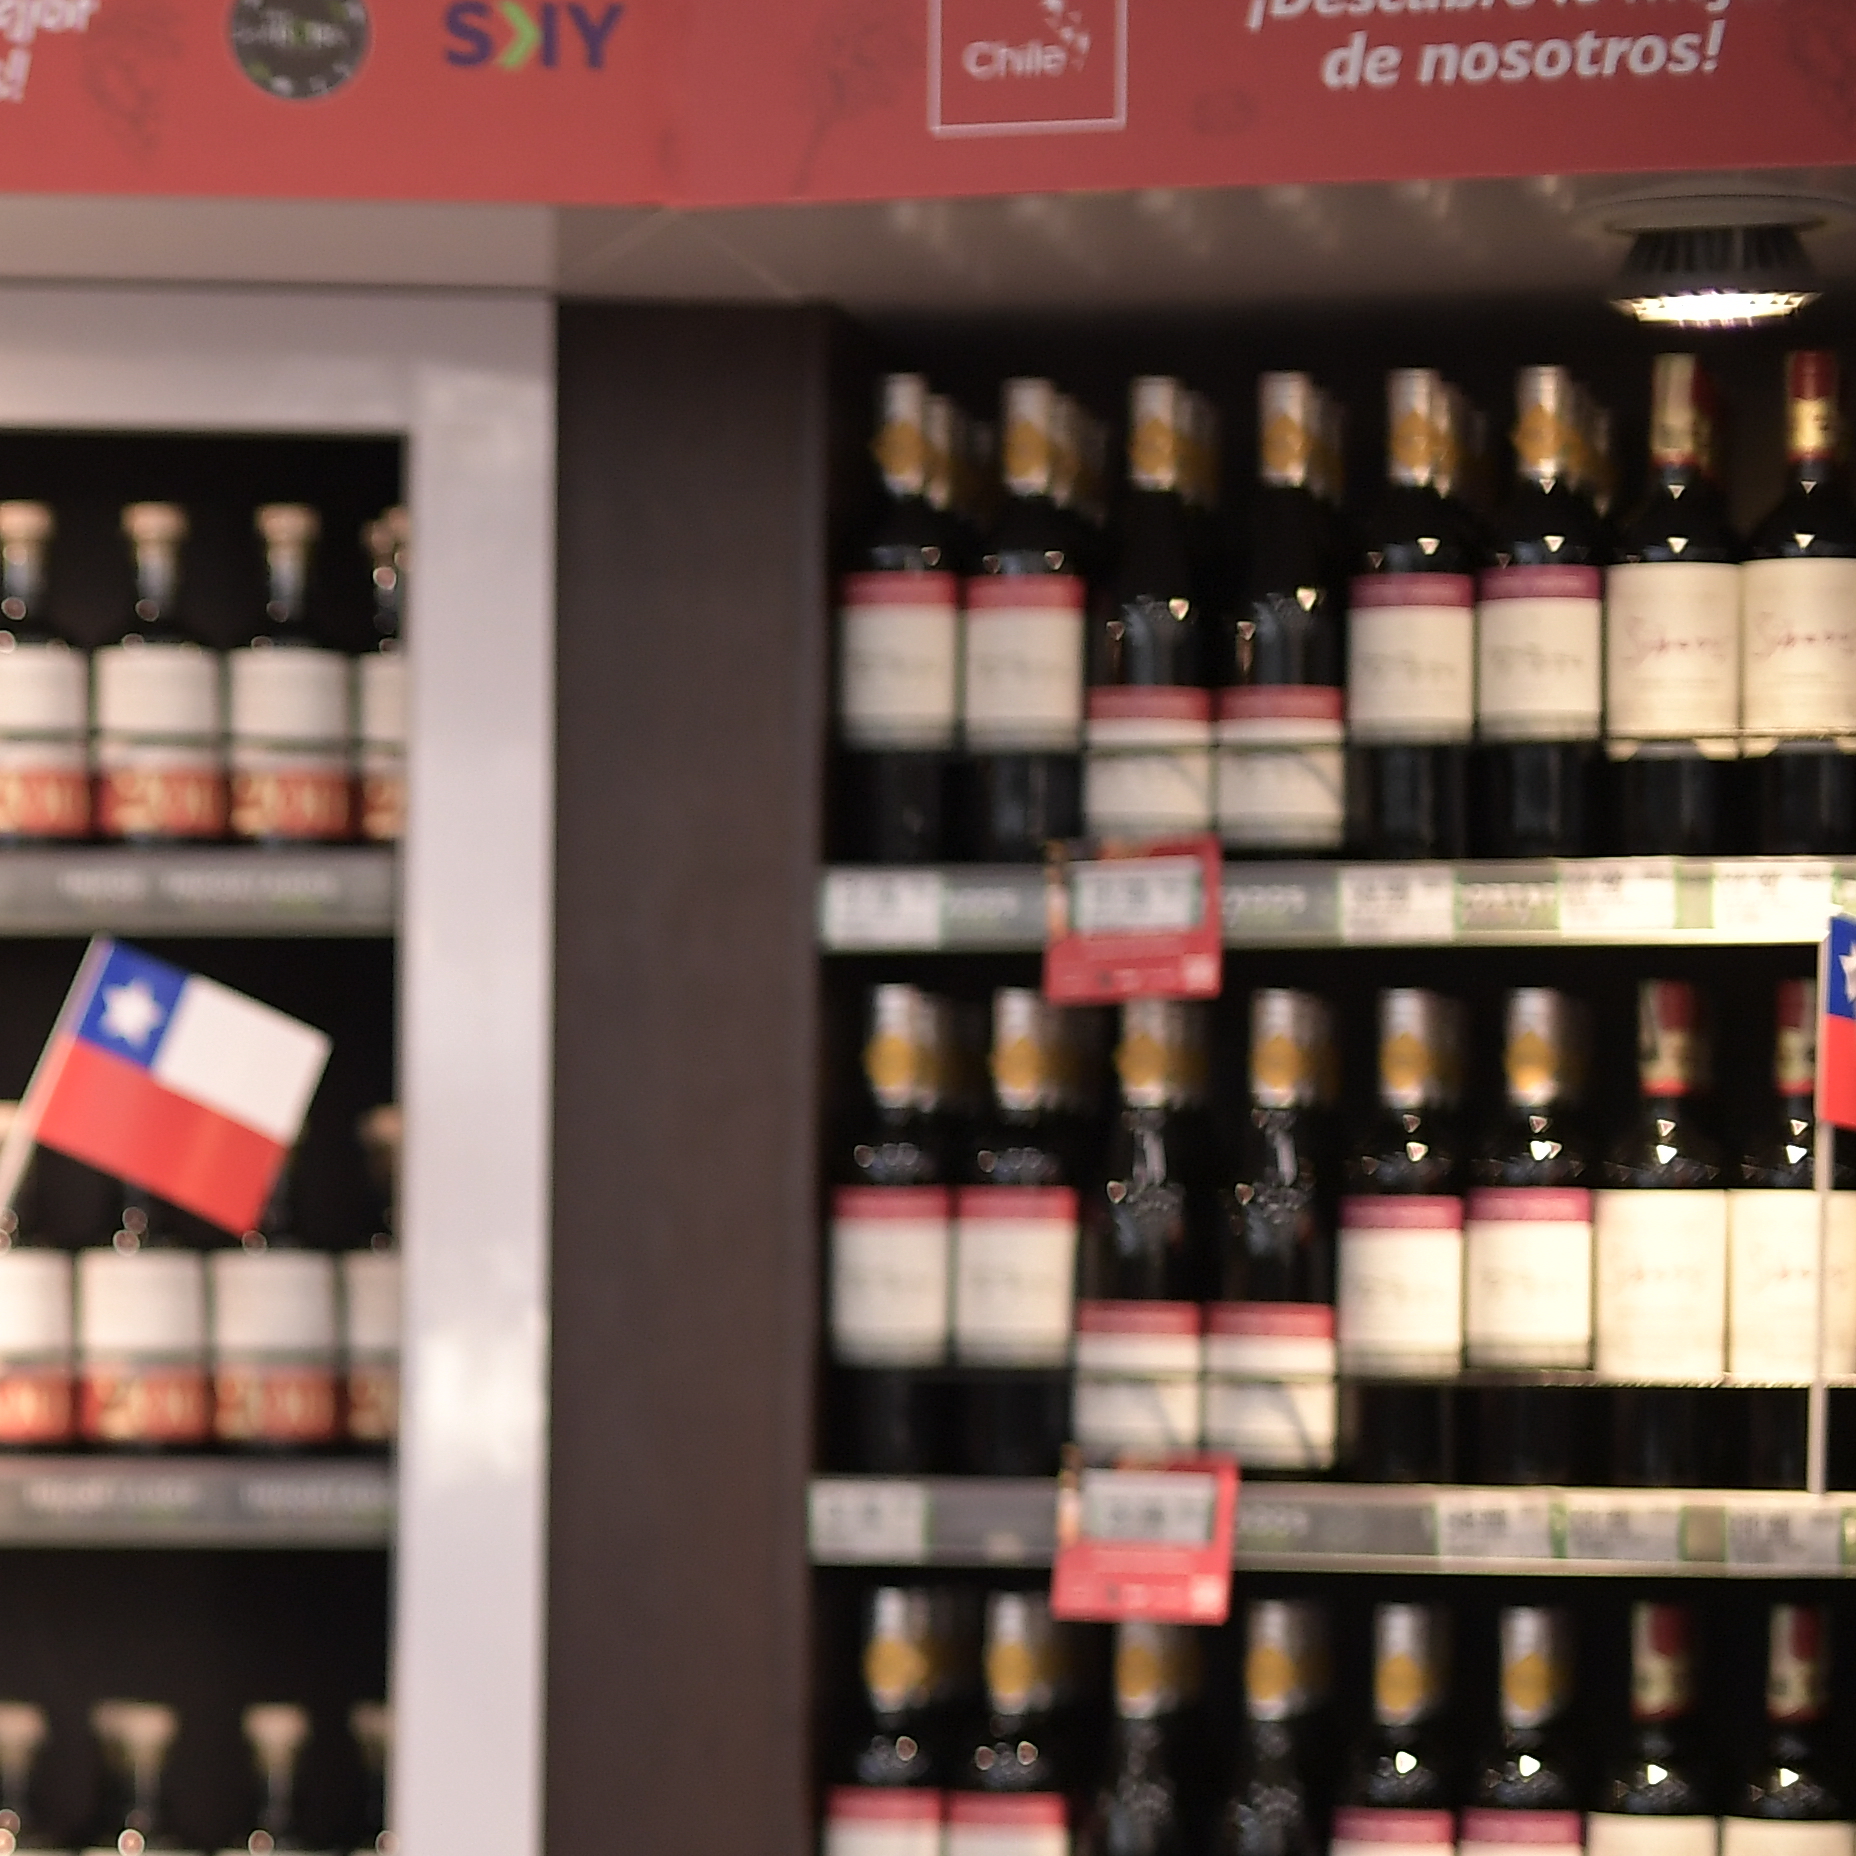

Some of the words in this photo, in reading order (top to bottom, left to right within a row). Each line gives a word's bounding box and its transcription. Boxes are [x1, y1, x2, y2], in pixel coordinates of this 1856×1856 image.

[962, 40, 1069, 80] Chile
[1320, 30, 1403, 88] de
[1416, 19, 1727, 85] nosotros!
